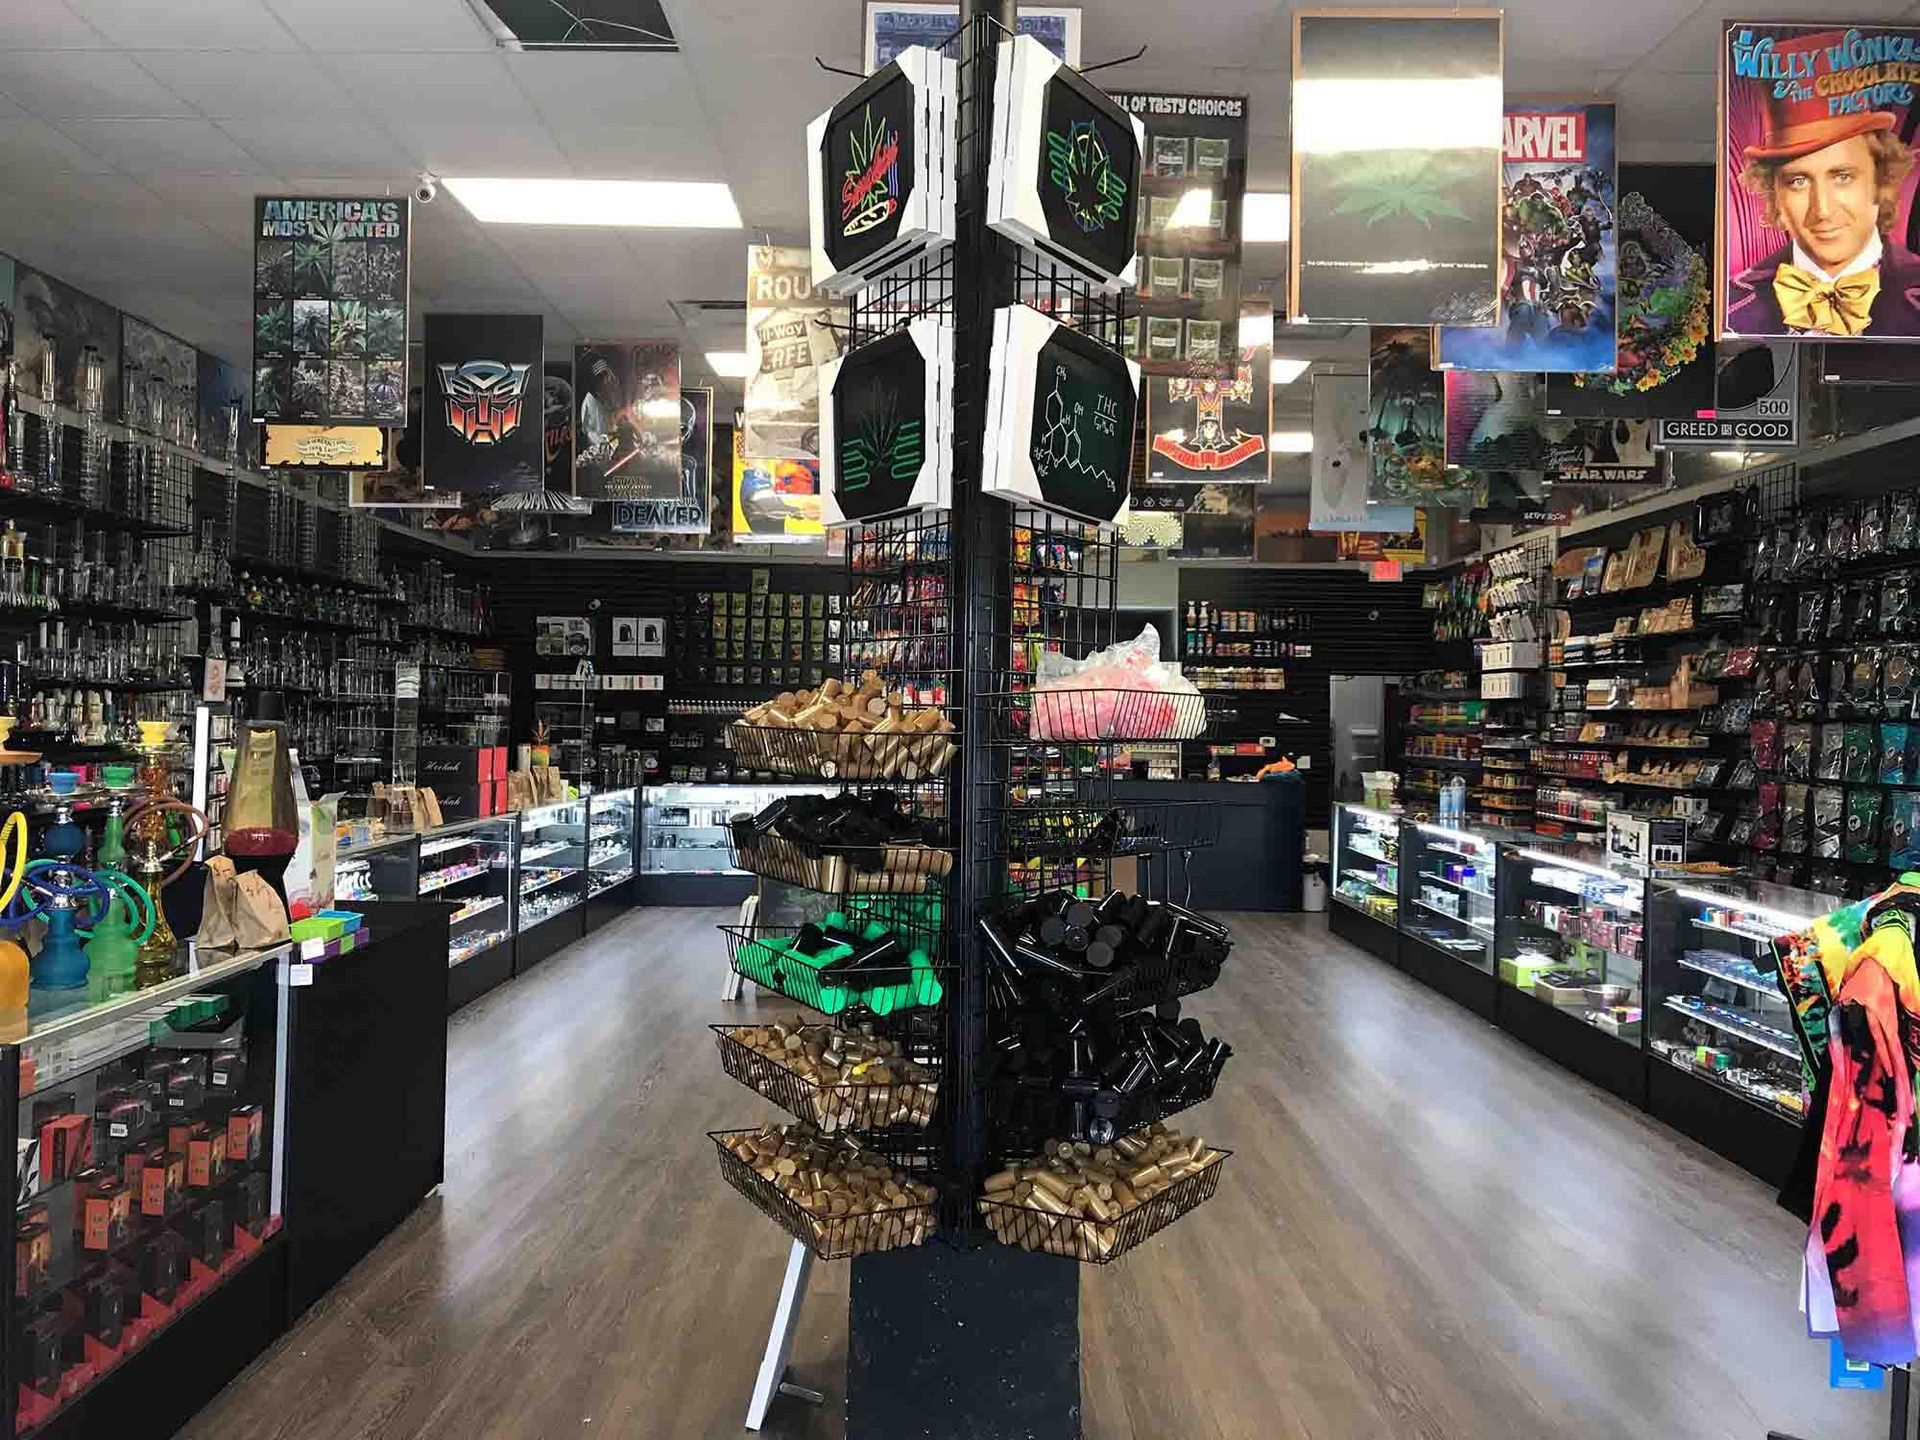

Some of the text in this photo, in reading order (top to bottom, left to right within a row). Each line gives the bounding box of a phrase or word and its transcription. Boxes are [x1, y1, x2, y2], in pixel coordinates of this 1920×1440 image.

[1733, 31, 1820, 78] WILLY
[1791, 86, 1813, 103] THE
[1815, 61, 1920, 96] CHOCOLATE
[1130, 96, 1147, 112] OF
[1828, 83, 1914, 116] FACTORY
[1502, 116, 1582, 158] ARVEL
[263, 200, 399, 222] AMERICA'S
[262, 221, 316, 237] MOST
[1096, 394, 1118, 418] THC
[1759, 400, 1789, 415] 500
[1666, 422, 1789, 437] GREED IS GOOD
[1560, 469, 1648, 480] STAR WARS
[617, 504, 703, 525] DEALER
